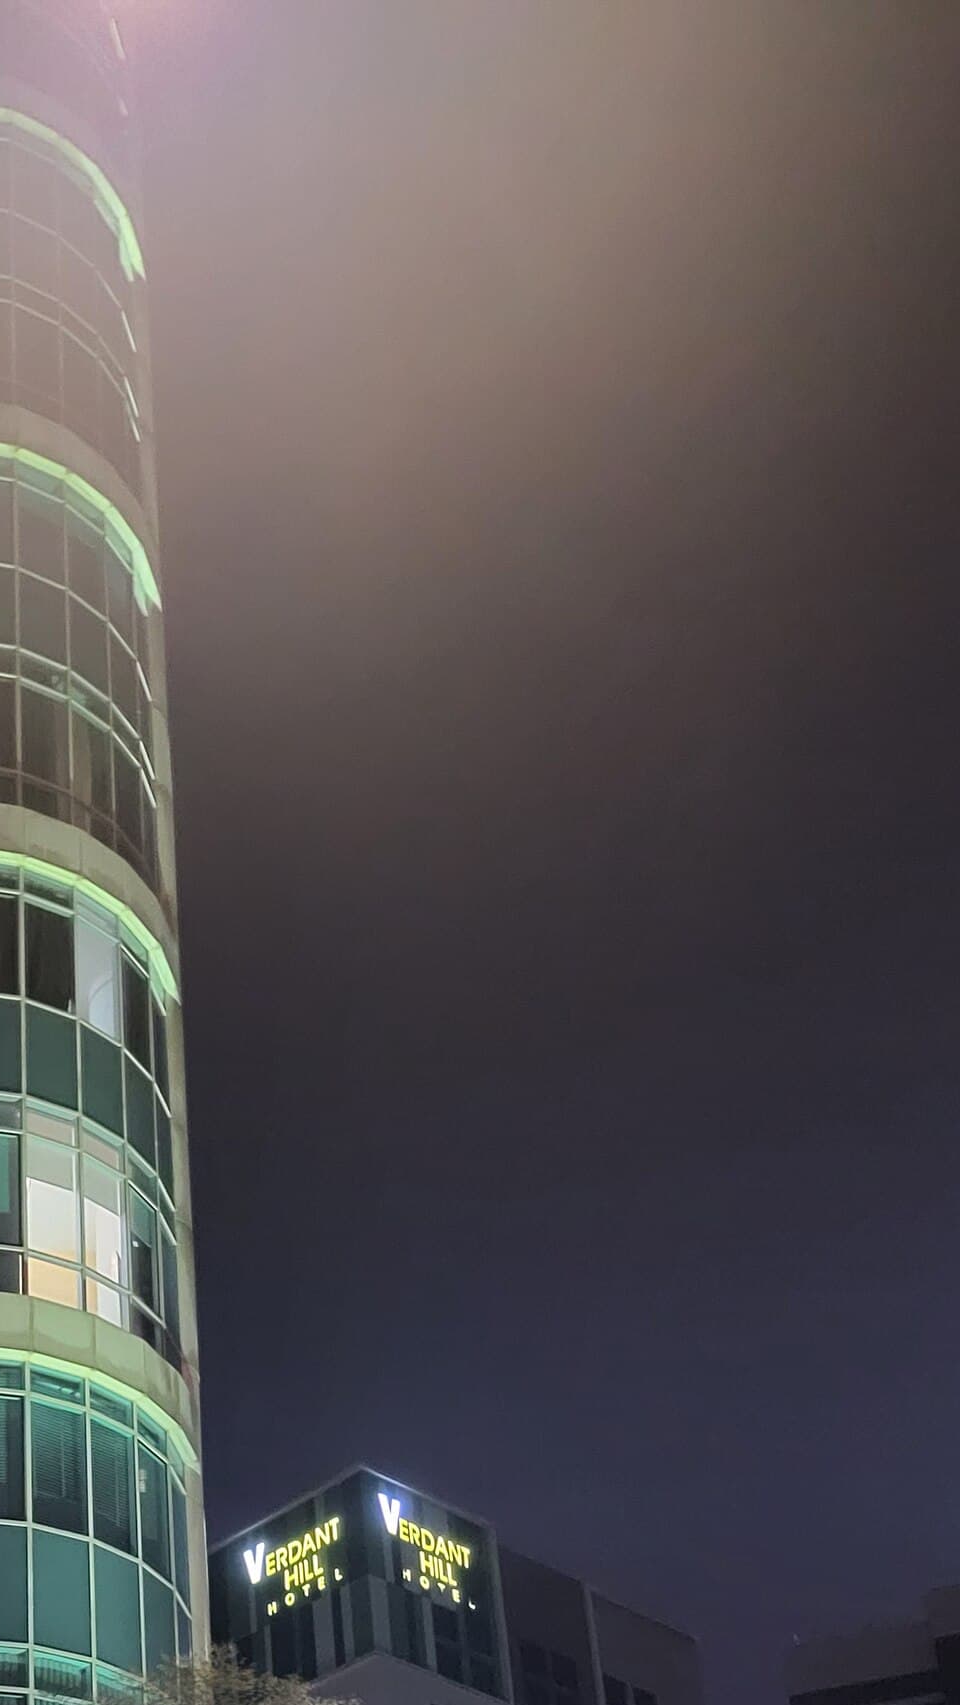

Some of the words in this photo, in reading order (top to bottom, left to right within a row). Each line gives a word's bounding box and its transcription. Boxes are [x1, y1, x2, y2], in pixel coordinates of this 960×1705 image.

[243, 1516, 340, 1585] VERDANT
[377, 1492, 471, 1569] VERDANT
[284, 1554, 324, 1591] HILL
[402, 1568, 476, 1610] HOTEL
[419, 1550, 458, 1587] HILL
[267, 1568, 343, 1617] HOTEL
